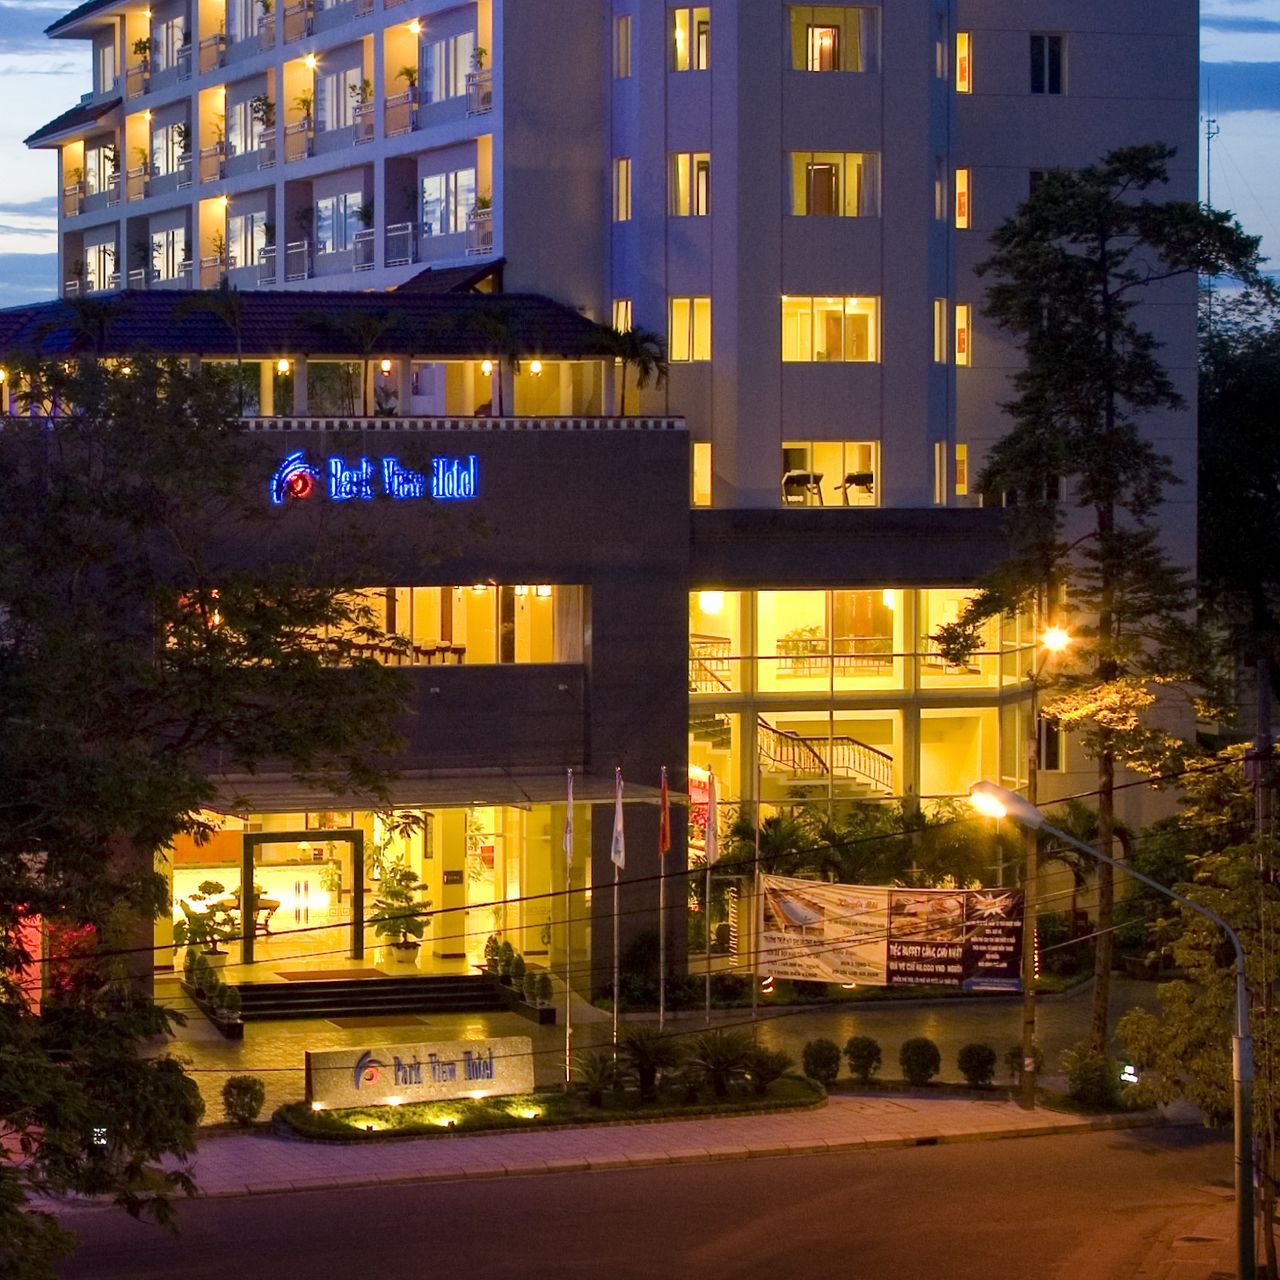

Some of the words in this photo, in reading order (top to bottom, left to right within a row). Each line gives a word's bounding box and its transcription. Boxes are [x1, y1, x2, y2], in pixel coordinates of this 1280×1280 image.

[431, 454, 479, 500] Hotel
[393, 1054, 422, 1086] Park
[428, 1052, 457, 1083] View
[464, 1047, 494, 1081] Hotel
